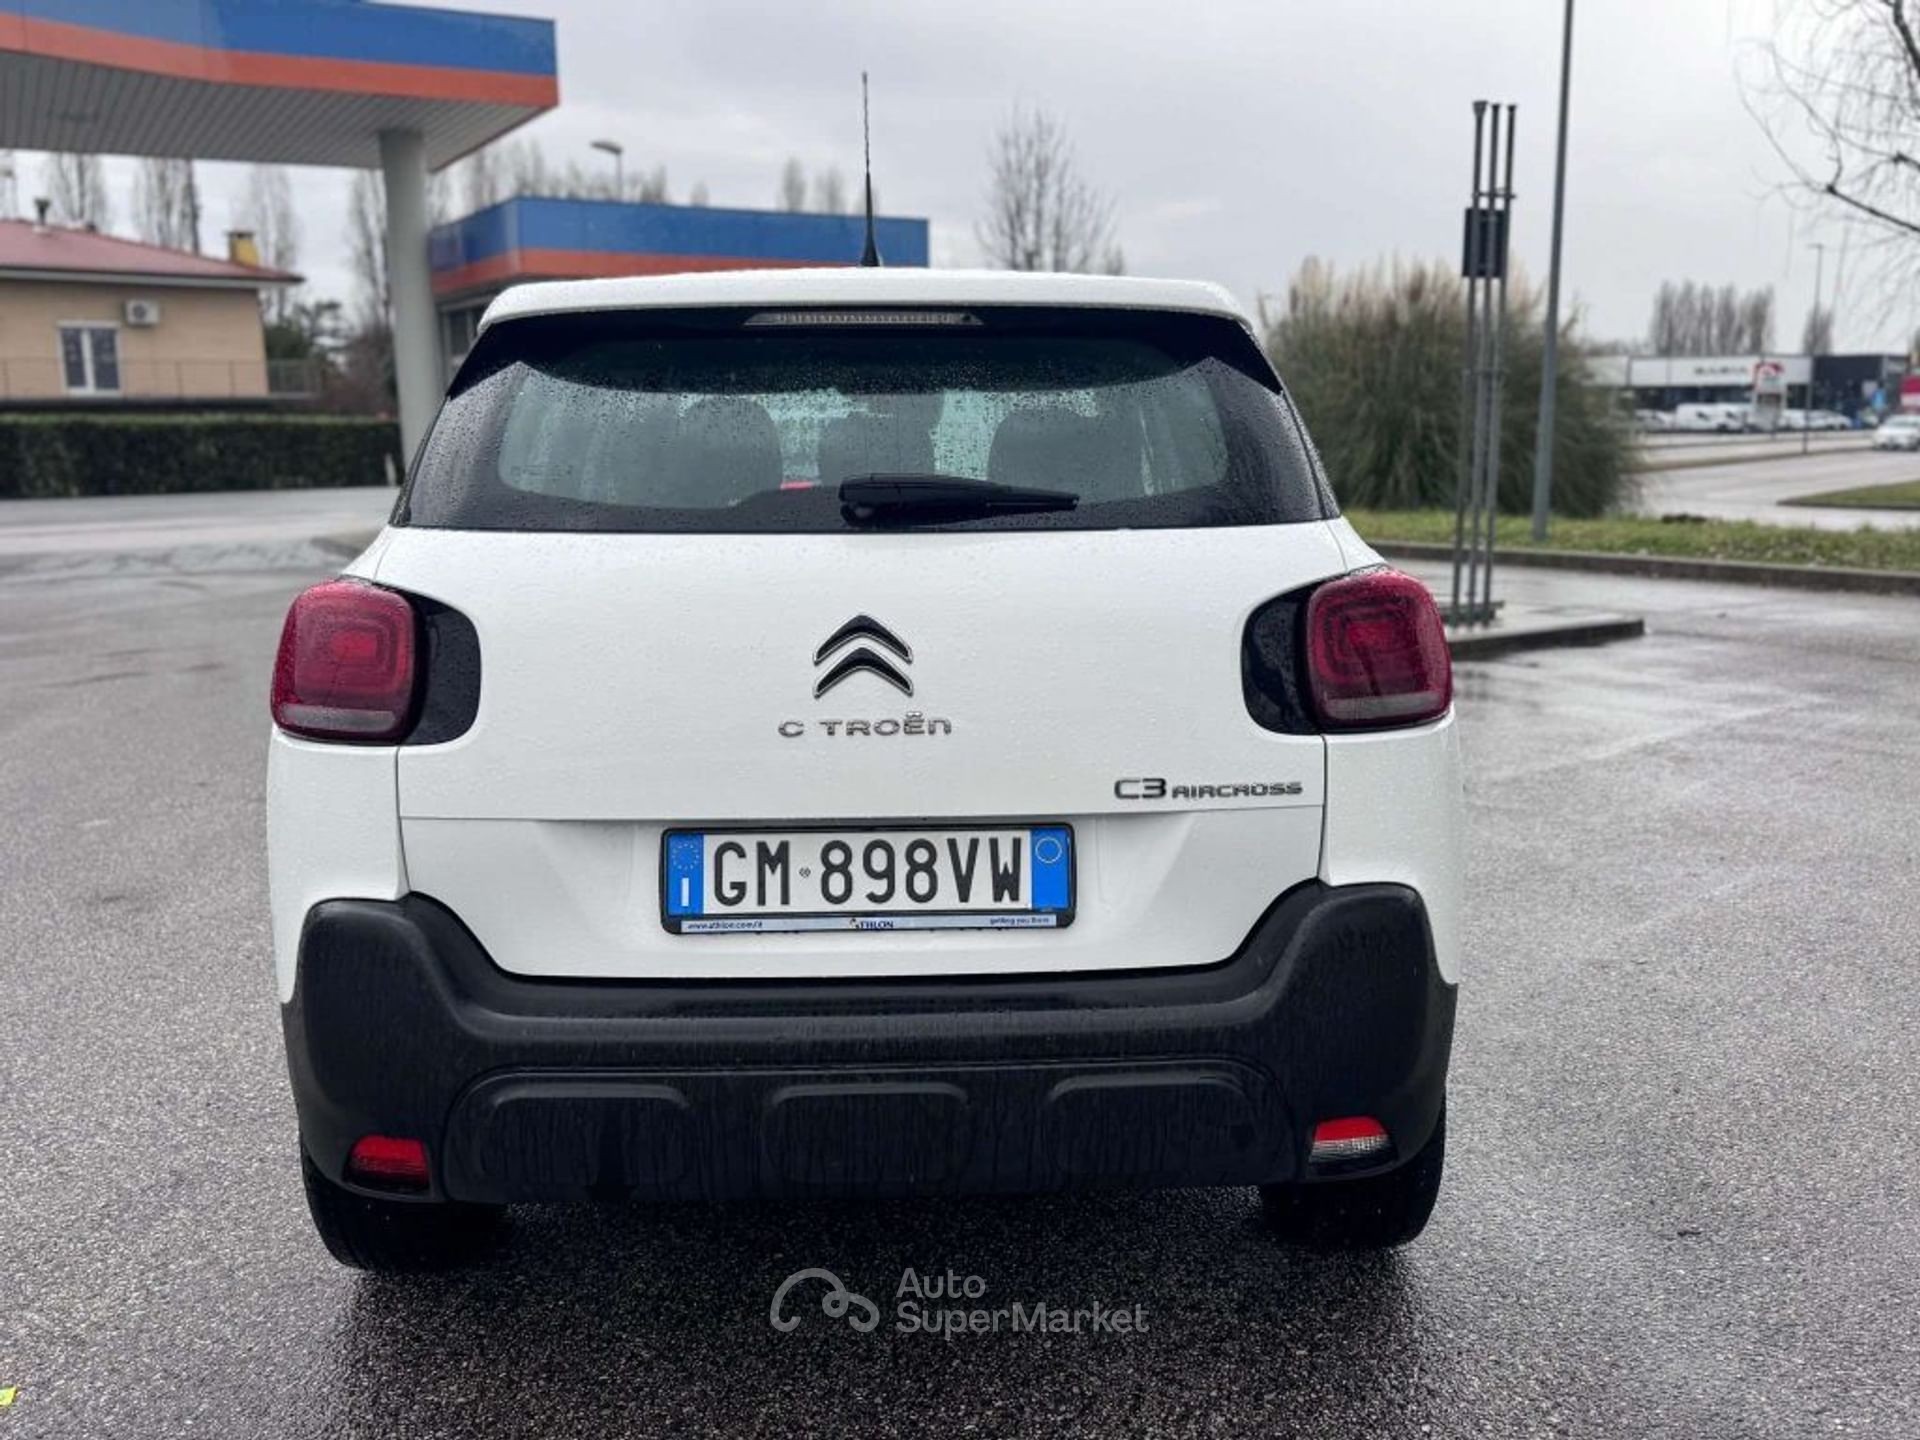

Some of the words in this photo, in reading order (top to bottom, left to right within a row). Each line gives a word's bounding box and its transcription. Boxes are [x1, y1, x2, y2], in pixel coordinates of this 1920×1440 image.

[778, 711, 952, 738] CTROËN
[1114, 777, 1167, 800] C3
[1172, 782, 1303, 799] AIRCROSS
[713, 840, 790, 907] GM
[819, 837, 1022, 905] 898VW
